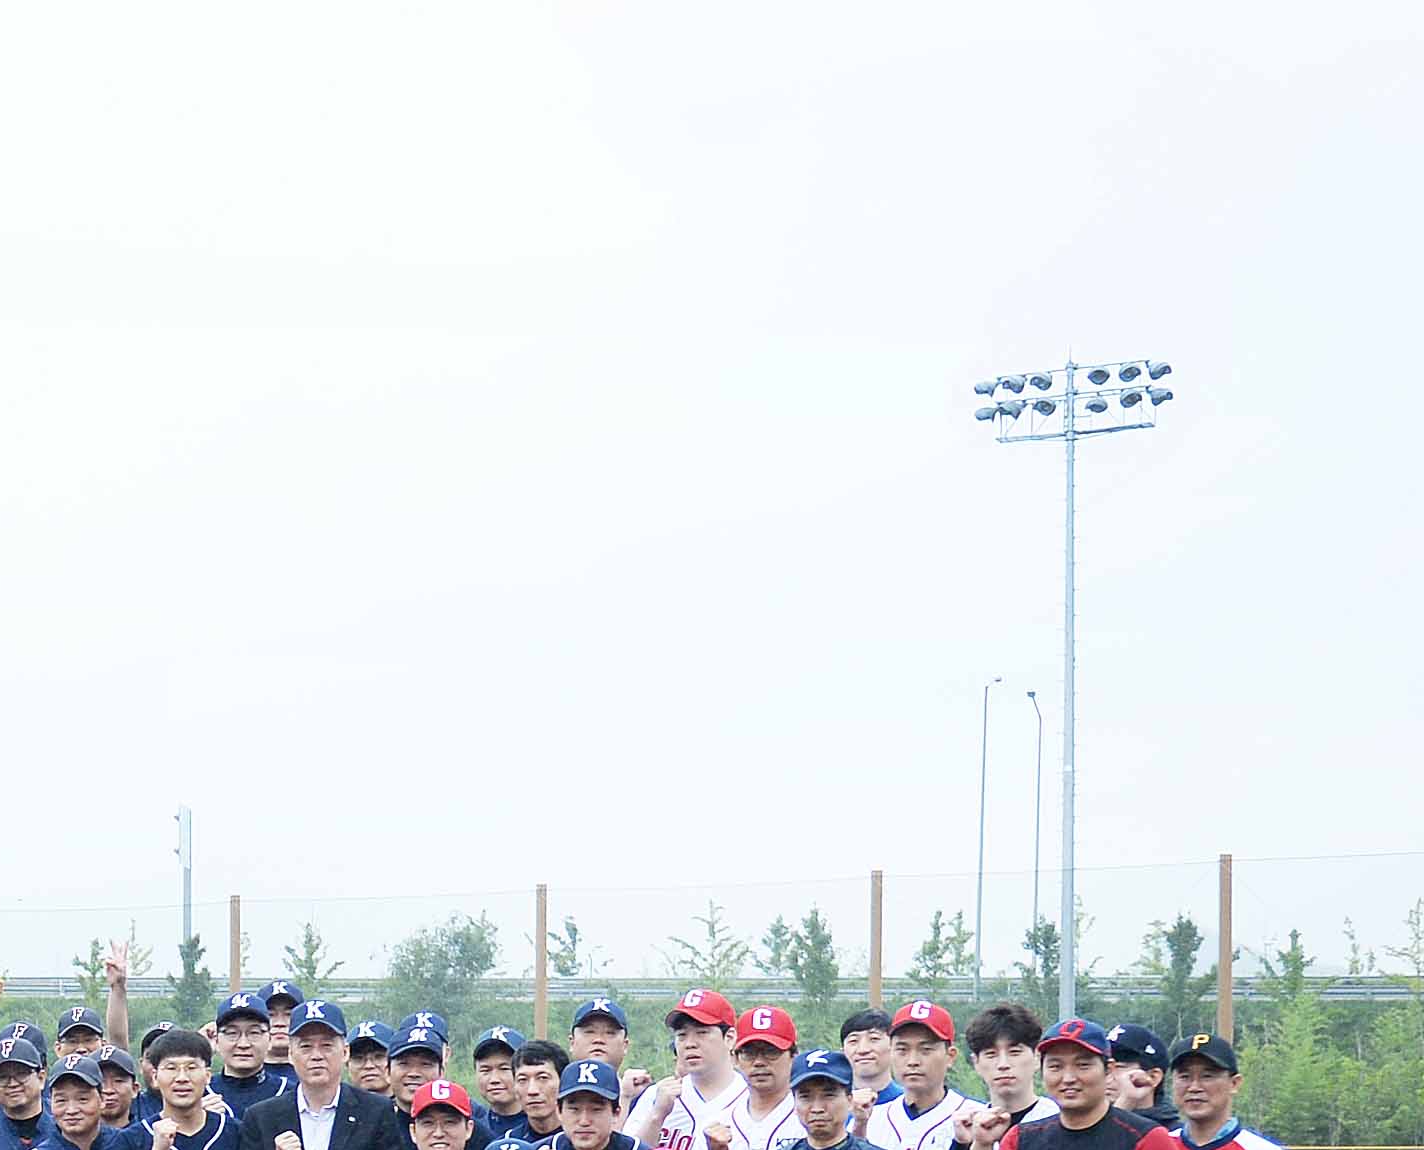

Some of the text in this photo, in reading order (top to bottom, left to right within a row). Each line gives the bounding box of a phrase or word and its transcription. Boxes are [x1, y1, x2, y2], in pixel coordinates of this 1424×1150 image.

[684, 991, 703, 1007] G
[911, 1002, 932, 1018] G
[753, 1010, 772, 1029] G
[1192, 1034, 1209, 1050] P
[432, 1080, 450, 1099] G
